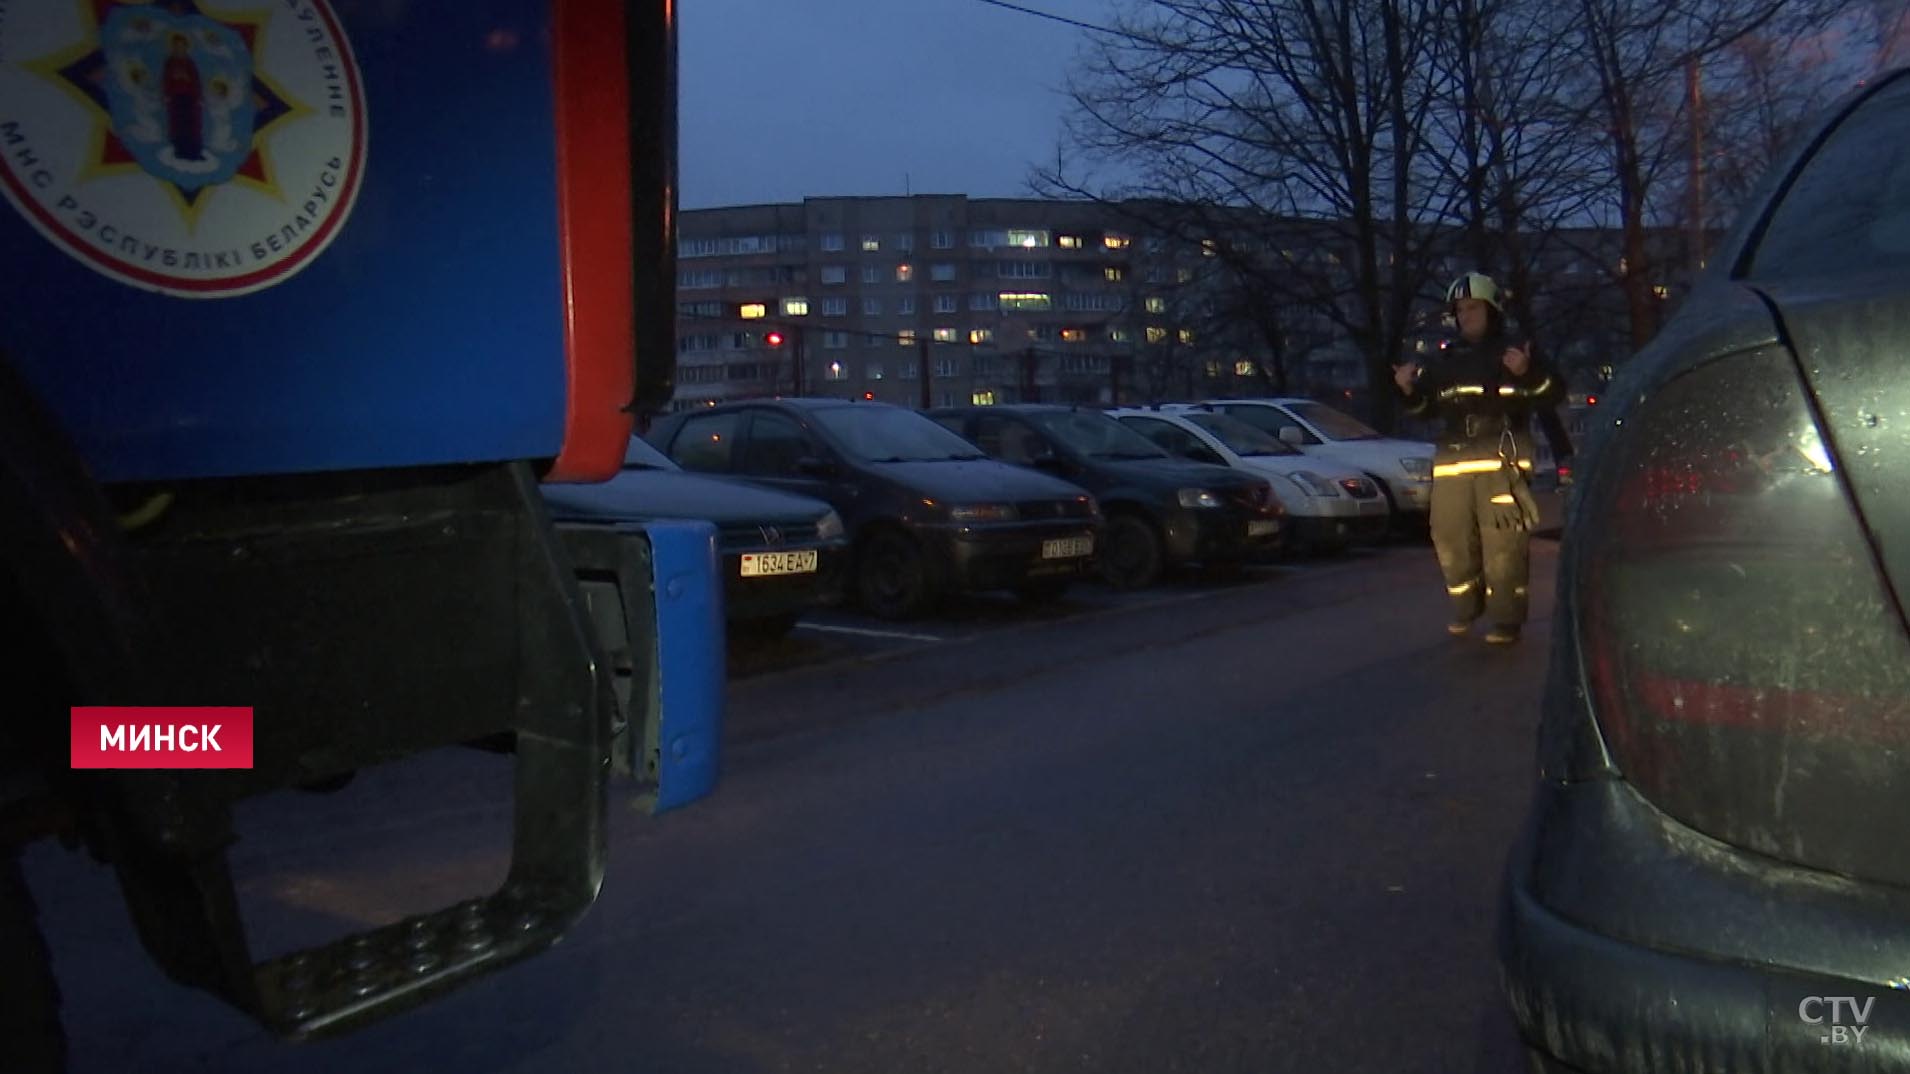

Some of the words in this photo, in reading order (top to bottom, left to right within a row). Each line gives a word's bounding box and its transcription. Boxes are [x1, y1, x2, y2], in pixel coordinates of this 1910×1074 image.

[1, 121, 51, 189] МНС
[58, 195, 243, 270] РЭСПУБЛІКІ
[251, 155, 342, 261] БЕЛАРУСЬ
